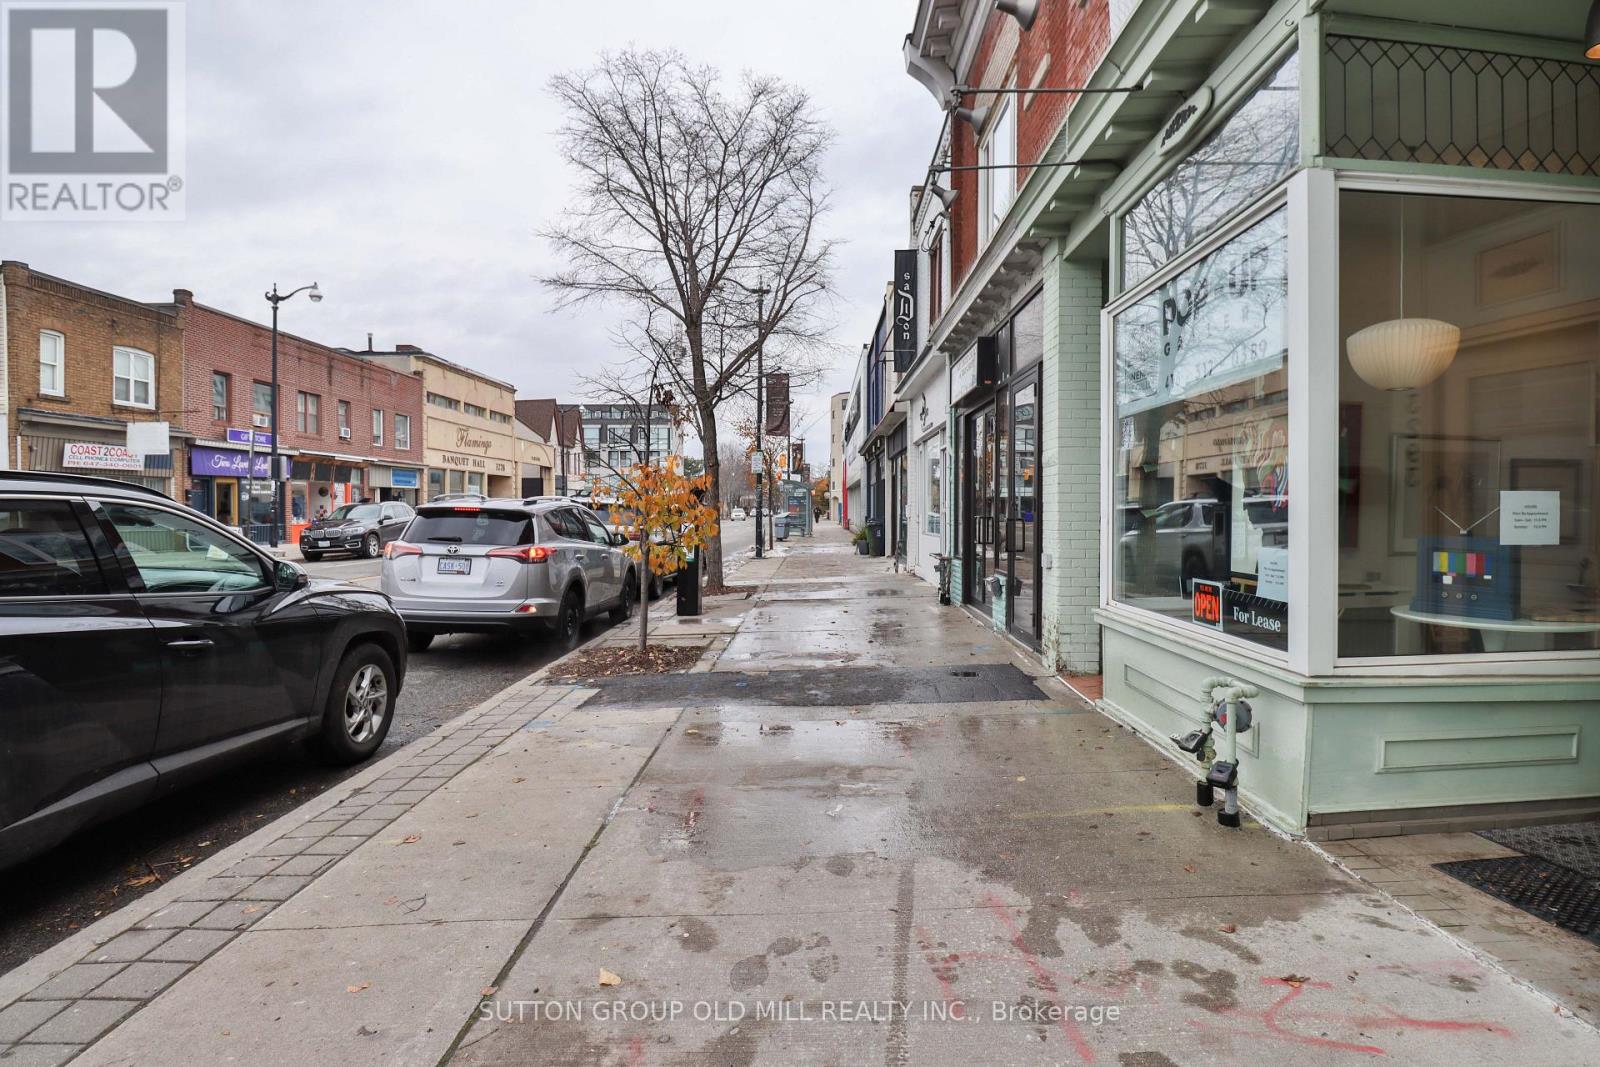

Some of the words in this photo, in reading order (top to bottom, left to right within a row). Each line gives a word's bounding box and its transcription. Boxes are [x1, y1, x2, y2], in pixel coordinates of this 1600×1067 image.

[456, 427, 492, 454] Flamingo
[442, 454, 469, 467] BANQUET
[473, 458, 485, 468] HALL
[1194, 591, 1219, 622] OPEN
[1233, 606, 1249, 623] For
[1252, 611, 1281, 632] Lease
